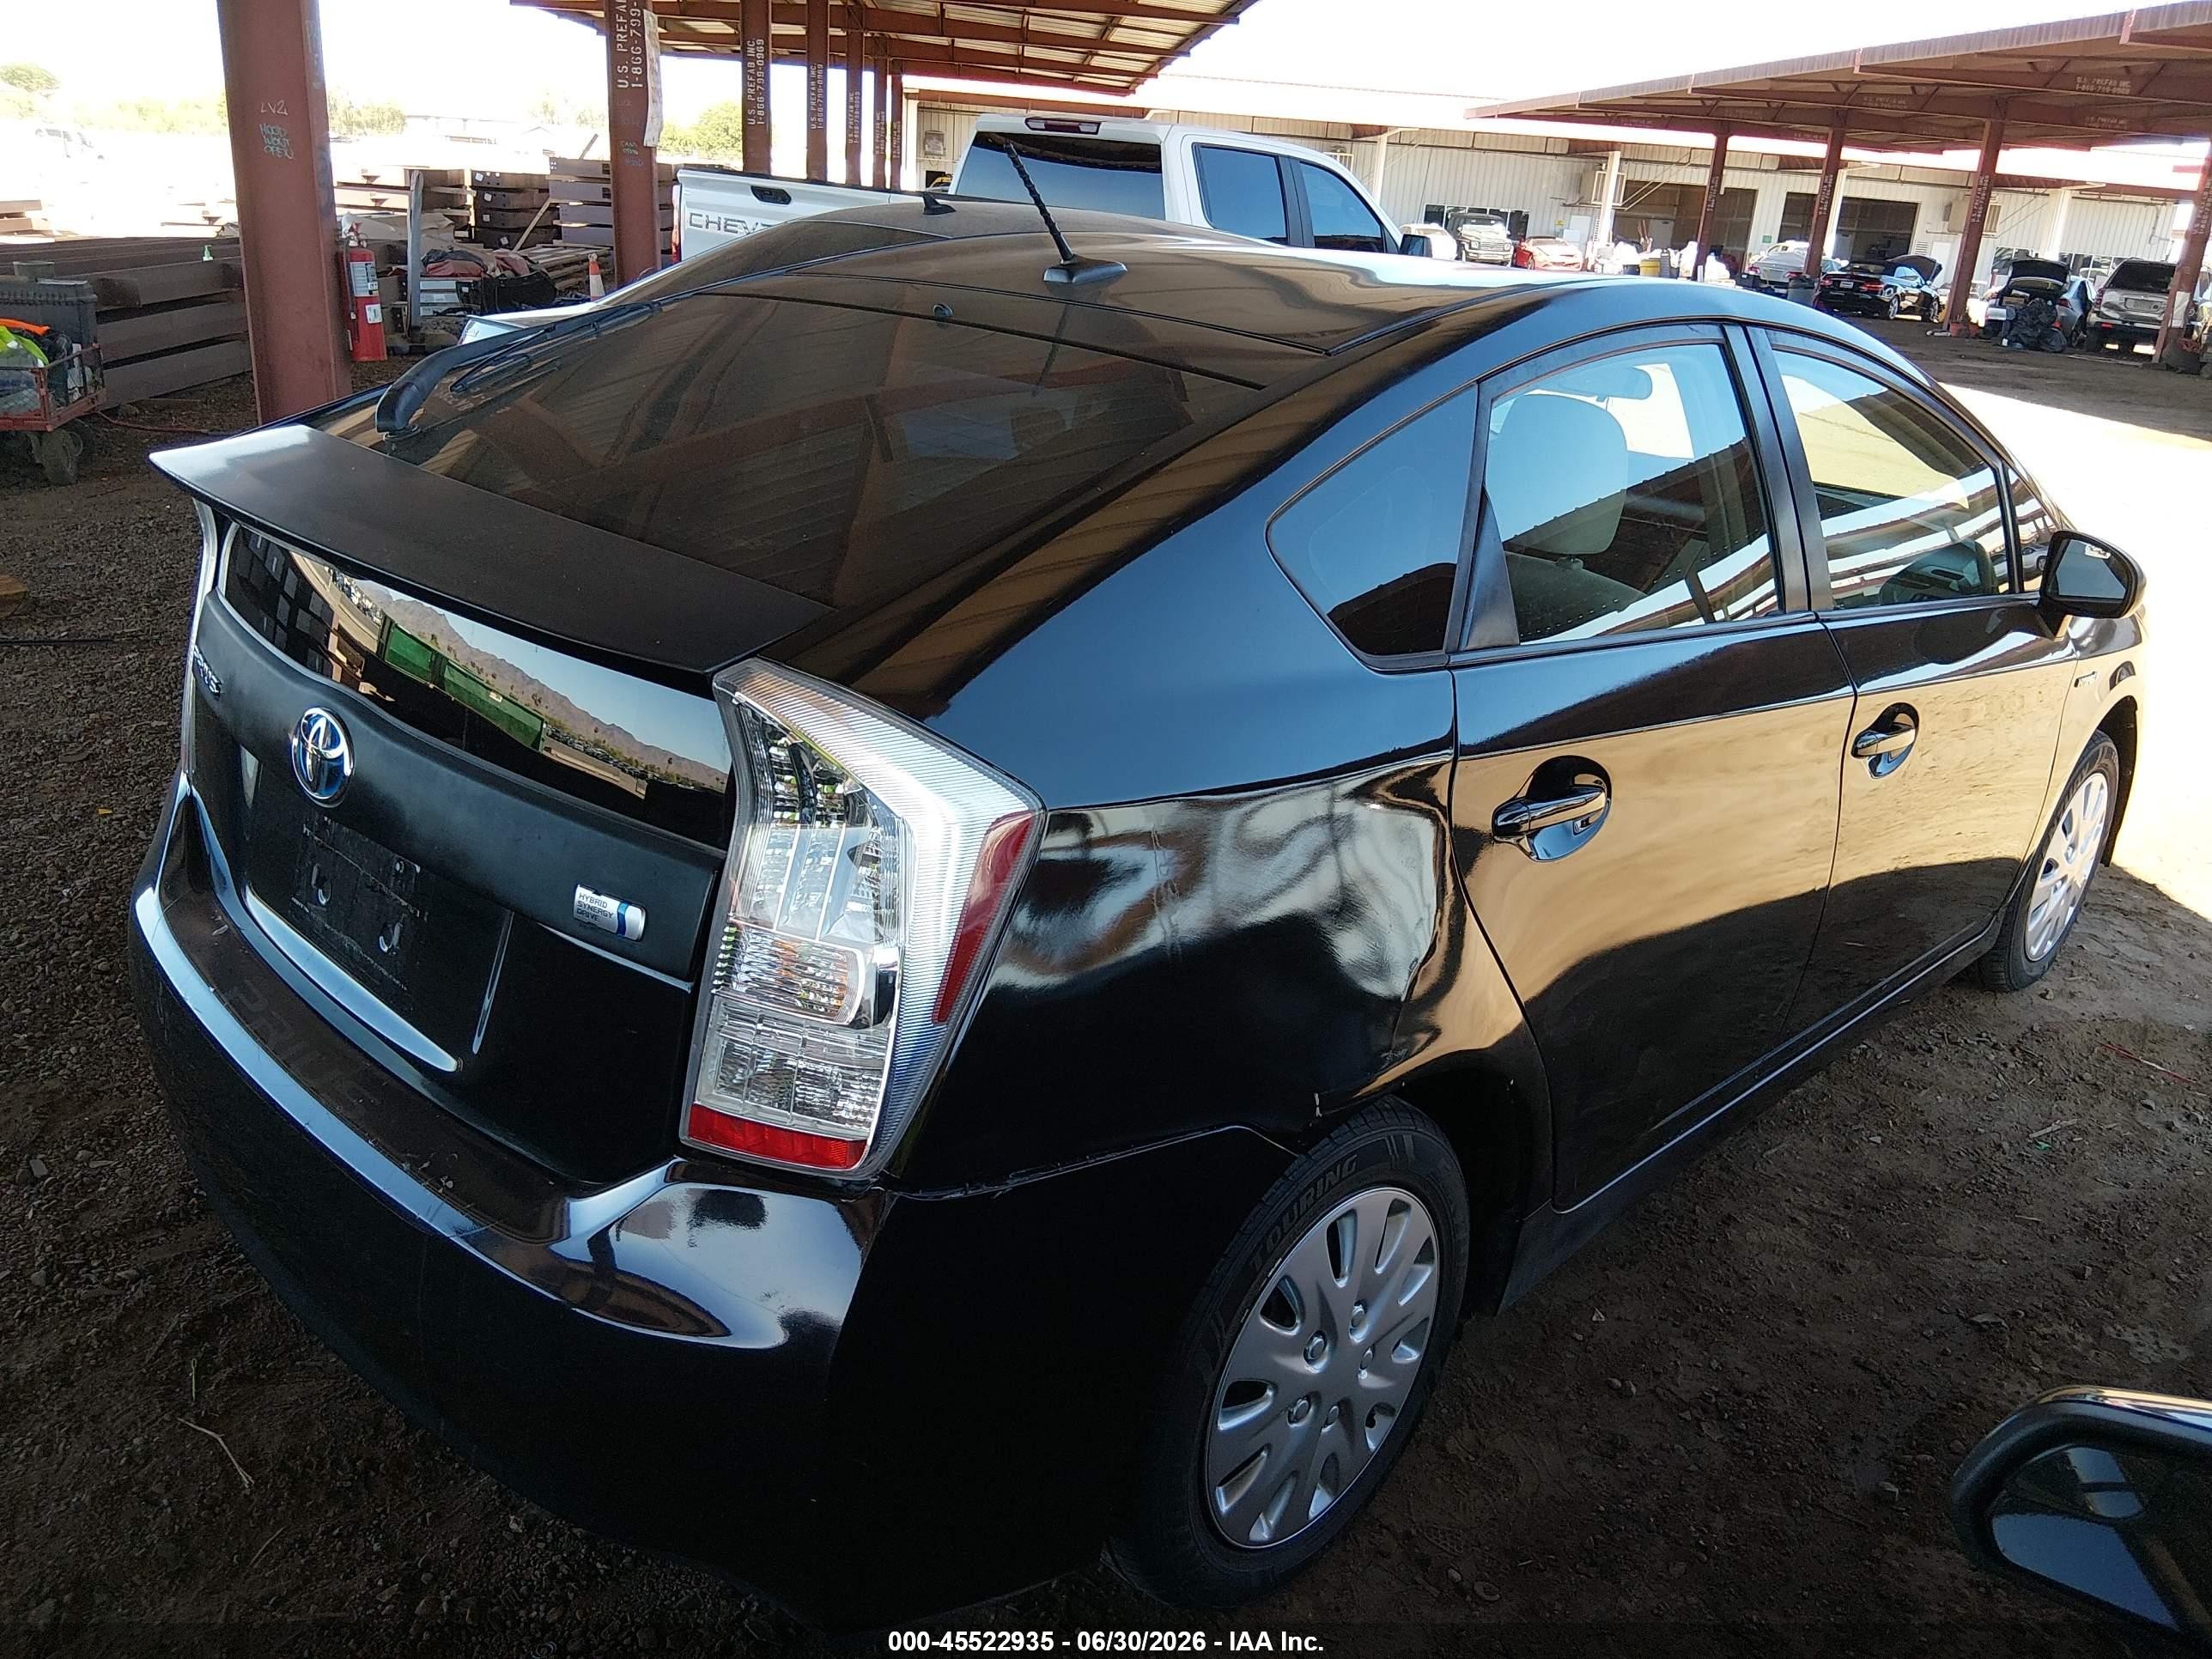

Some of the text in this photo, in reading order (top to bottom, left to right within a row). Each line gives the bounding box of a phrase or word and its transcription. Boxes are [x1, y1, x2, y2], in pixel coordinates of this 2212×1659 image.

[617, 61, 629, 89] U.S.
[746, 38, 756, 125] U.S. PREFAB INC.
[757, 39, 765, 125] 1-866-799-0969
[689, 212, 774, 235] CHEV
[577, 900, 614, 919] SYNERGY
[578, 892, 608, 908] HYBRID
[576, 908, 600, 922] DRIVE
[1250, 1153, 1358, 1271] TOURING
